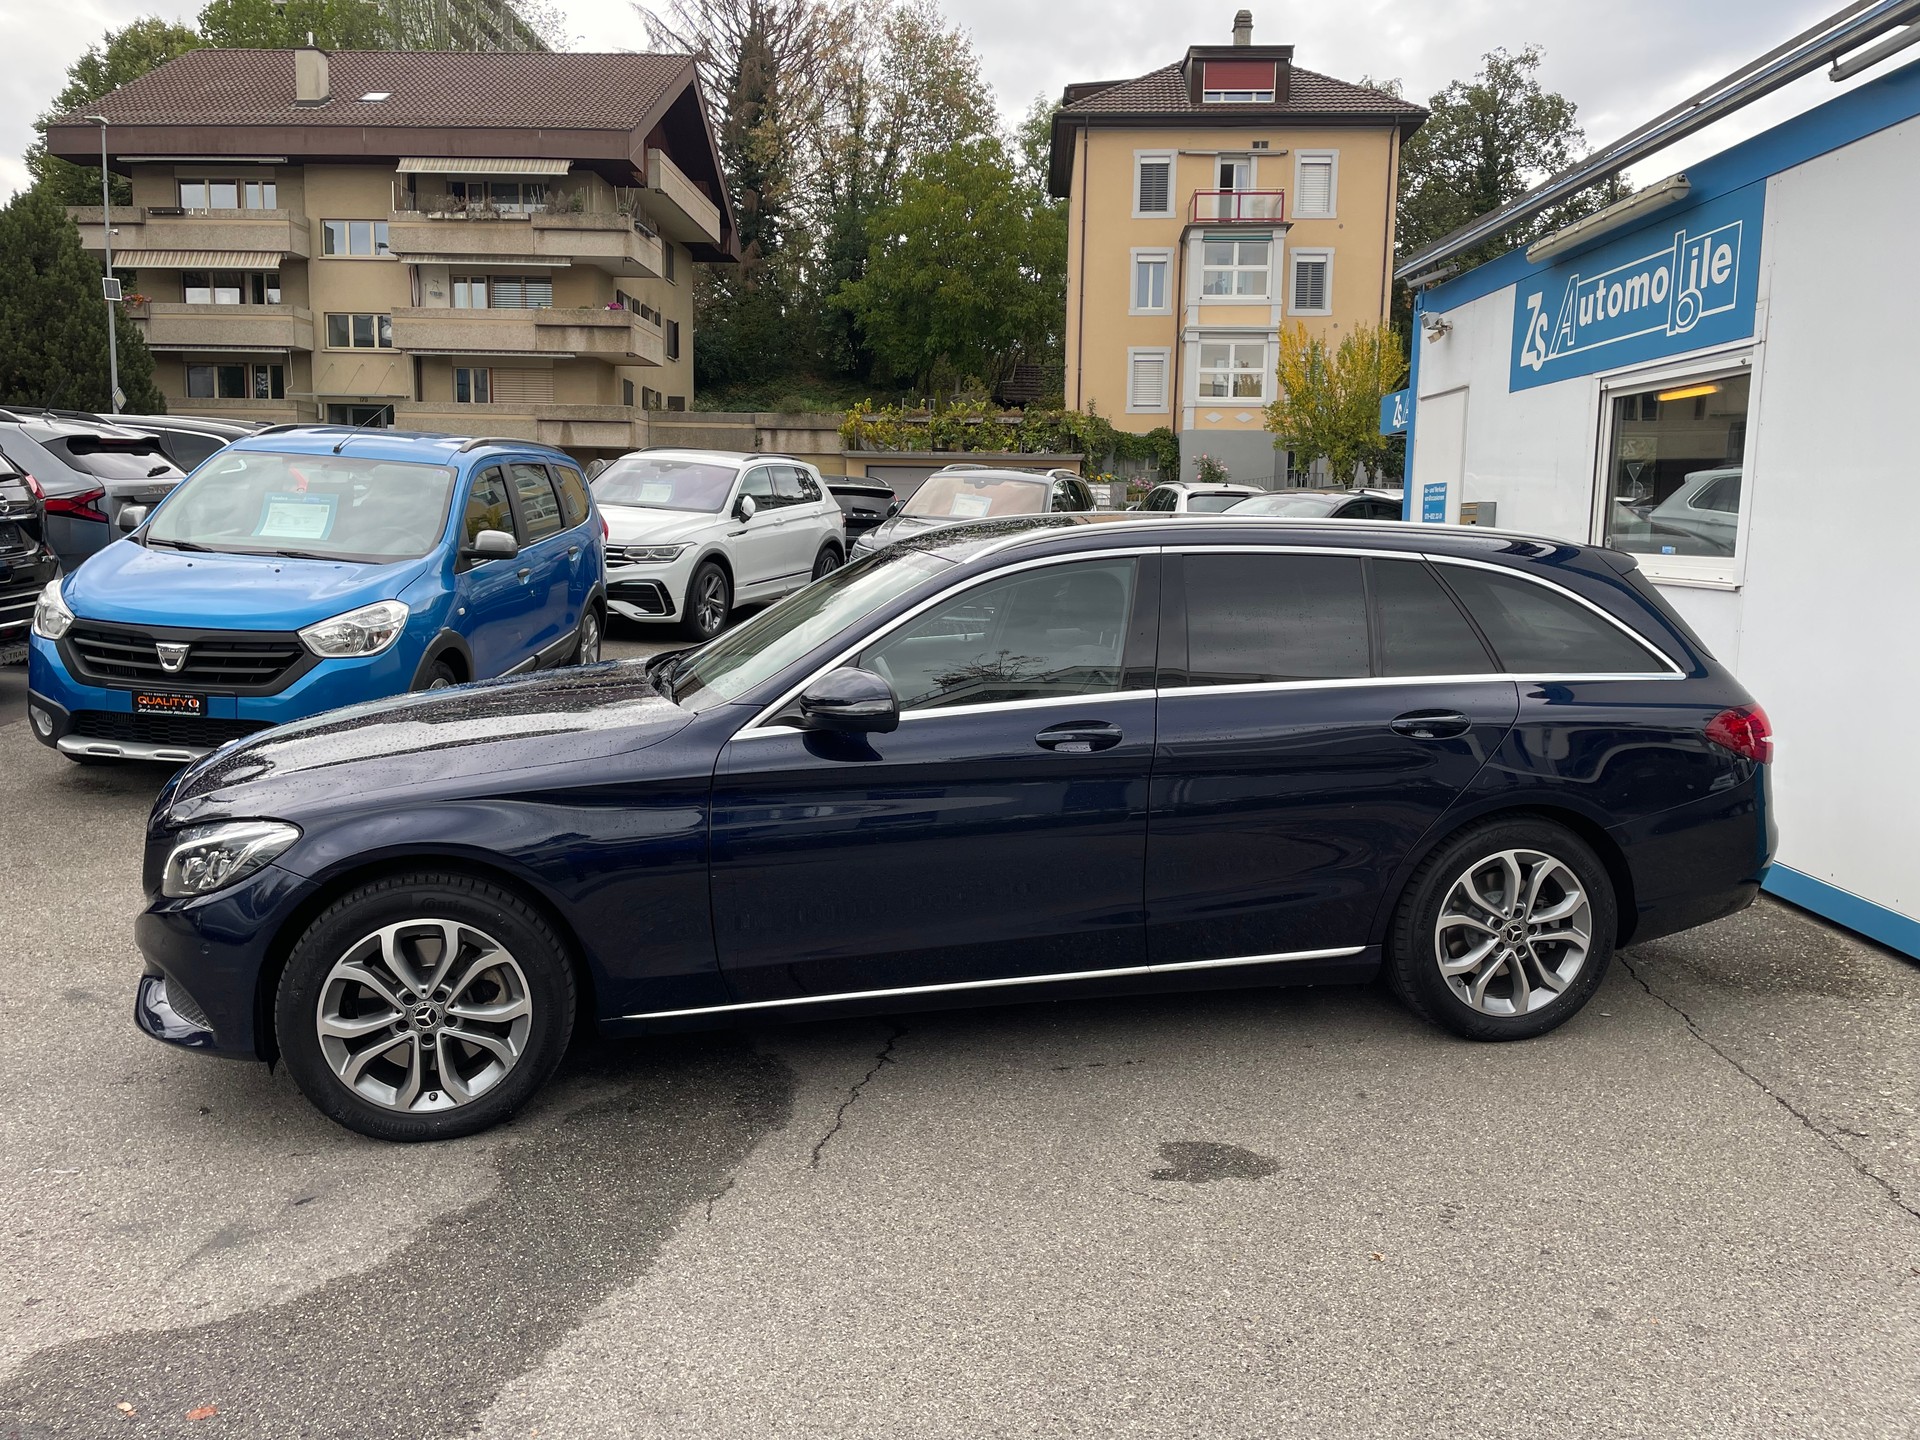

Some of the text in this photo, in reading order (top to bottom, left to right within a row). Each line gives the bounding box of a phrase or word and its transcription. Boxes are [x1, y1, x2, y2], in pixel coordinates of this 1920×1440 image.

[1520, 230, 1732, 371] Zs Automobile
[137, 696, 187, 706] QUALITY
